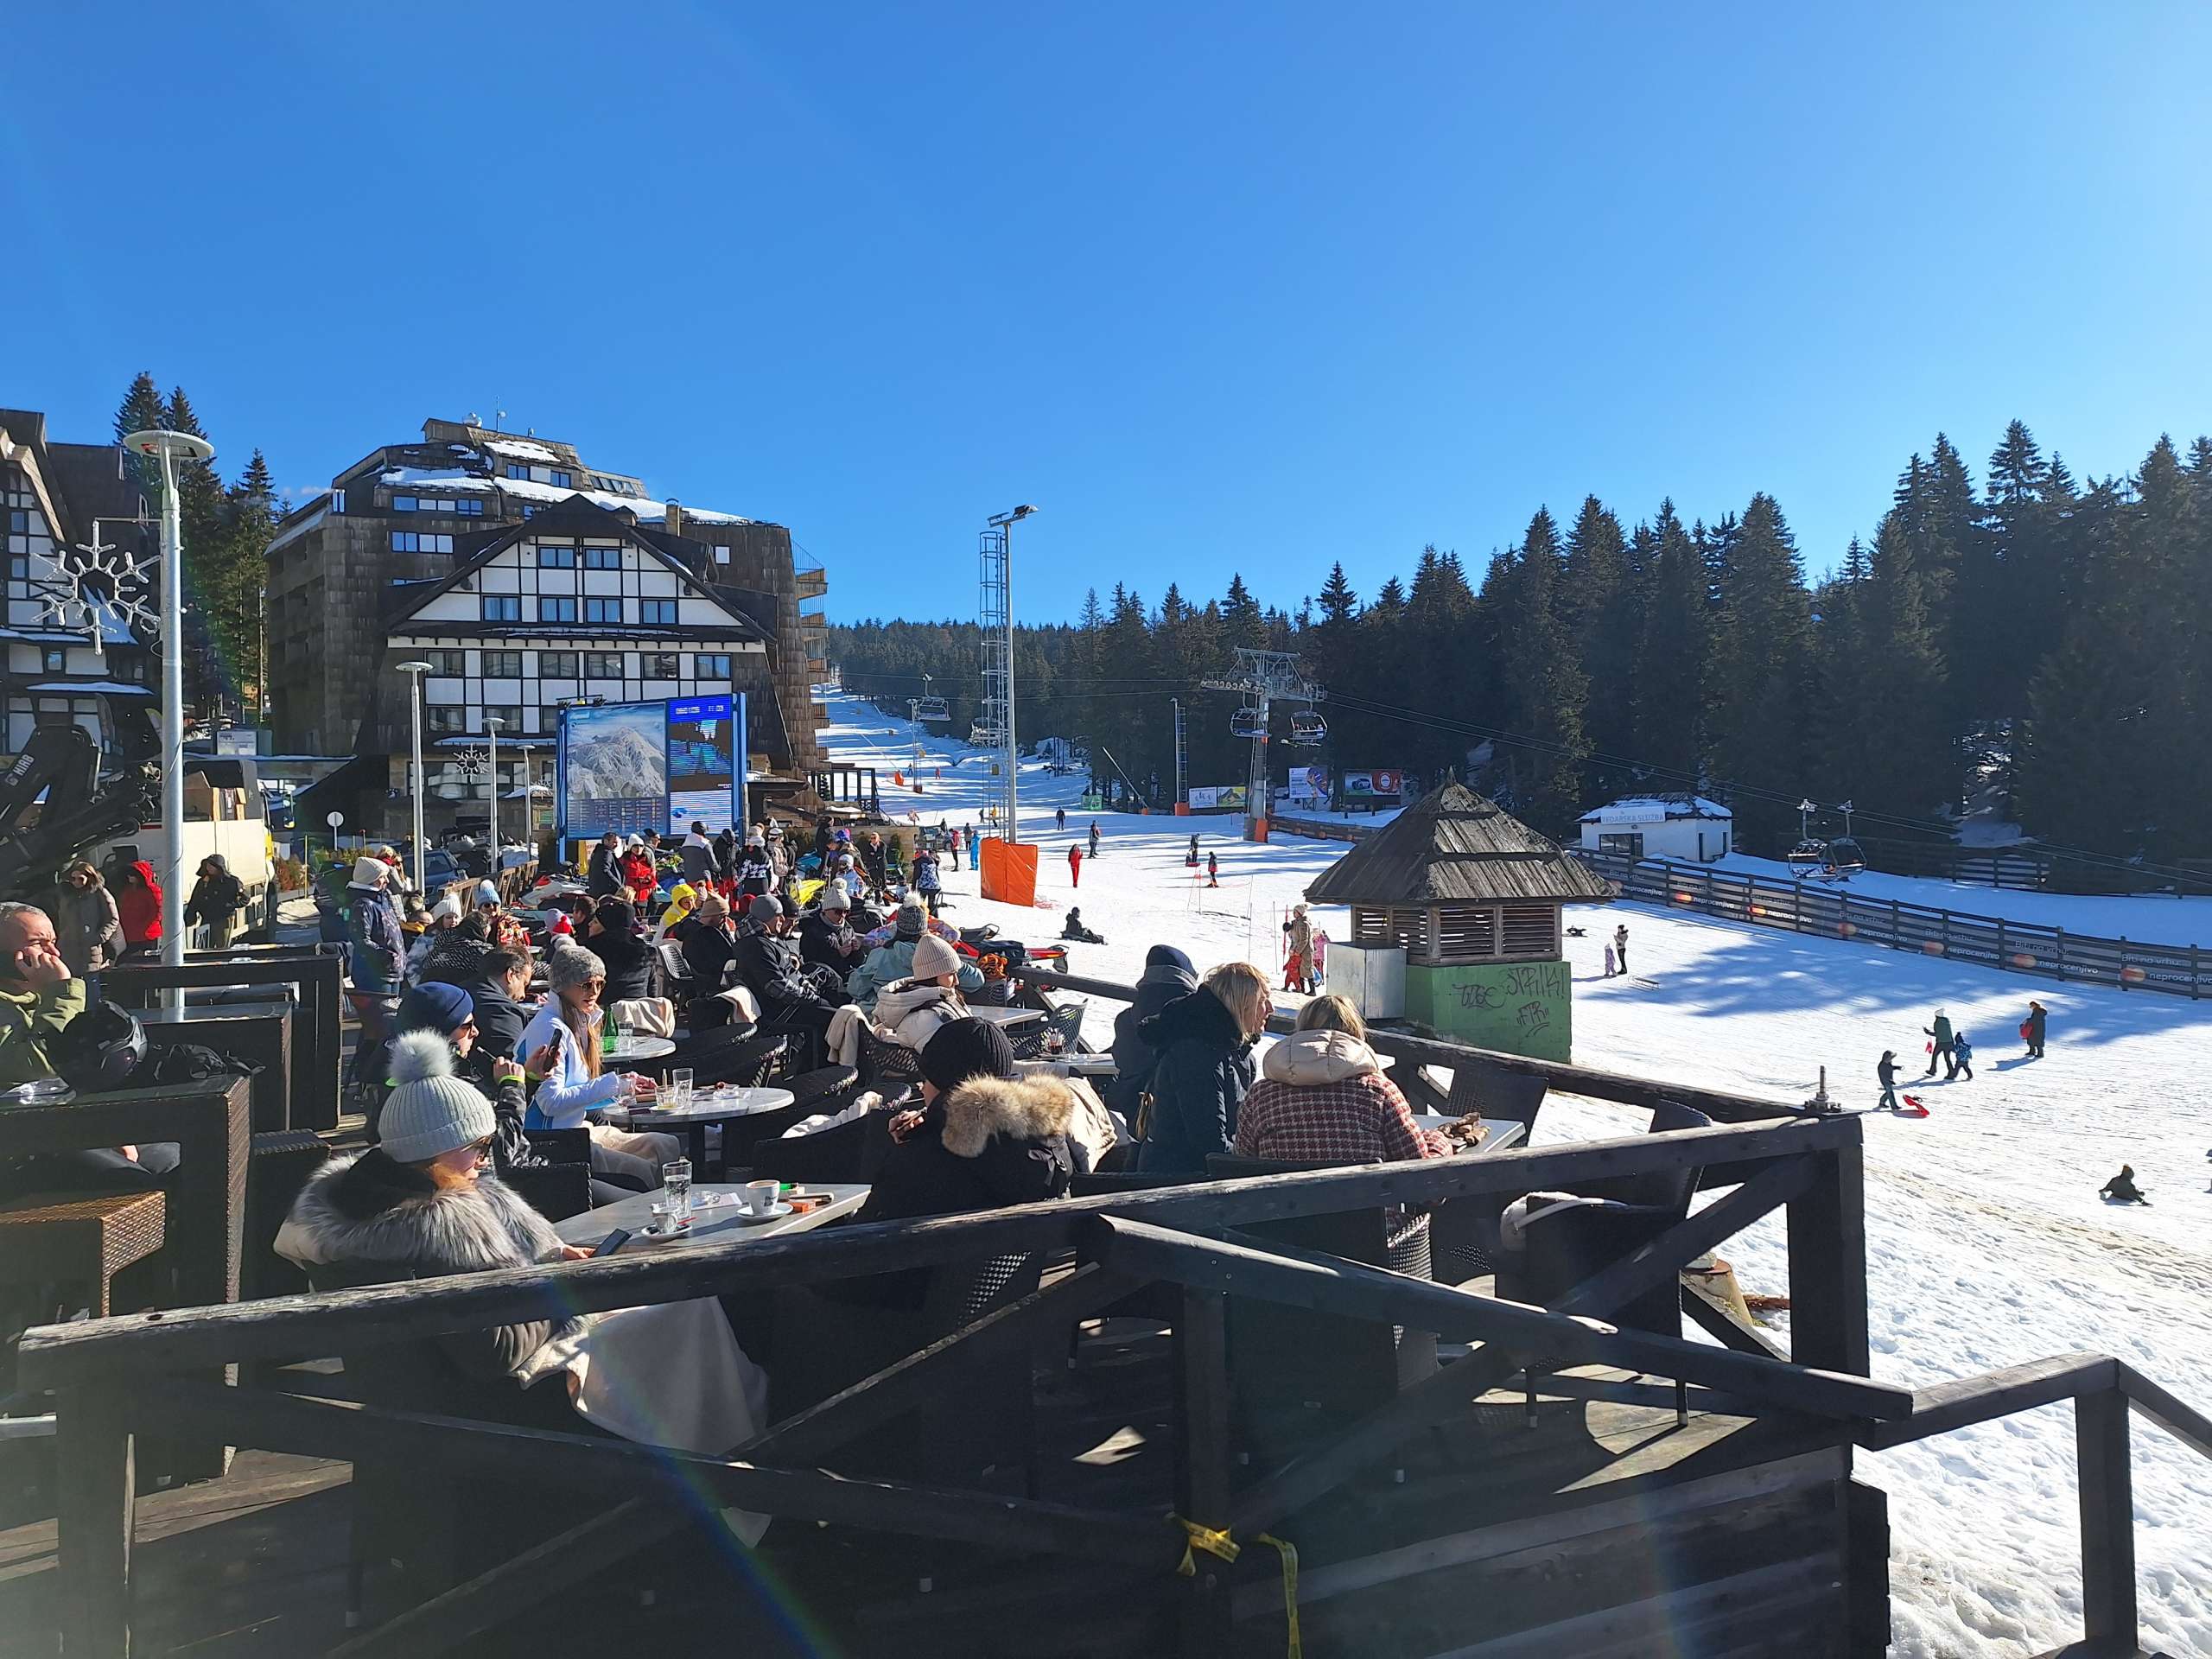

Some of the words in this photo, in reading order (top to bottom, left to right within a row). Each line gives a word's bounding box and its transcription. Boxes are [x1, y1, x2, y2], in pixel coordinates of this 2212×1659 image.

[12, 754, 35, 776] HIAB
[1767, 910, 1813, 923] neprocejivo
[2039, 960, 2099, 974] neprocenjivo
